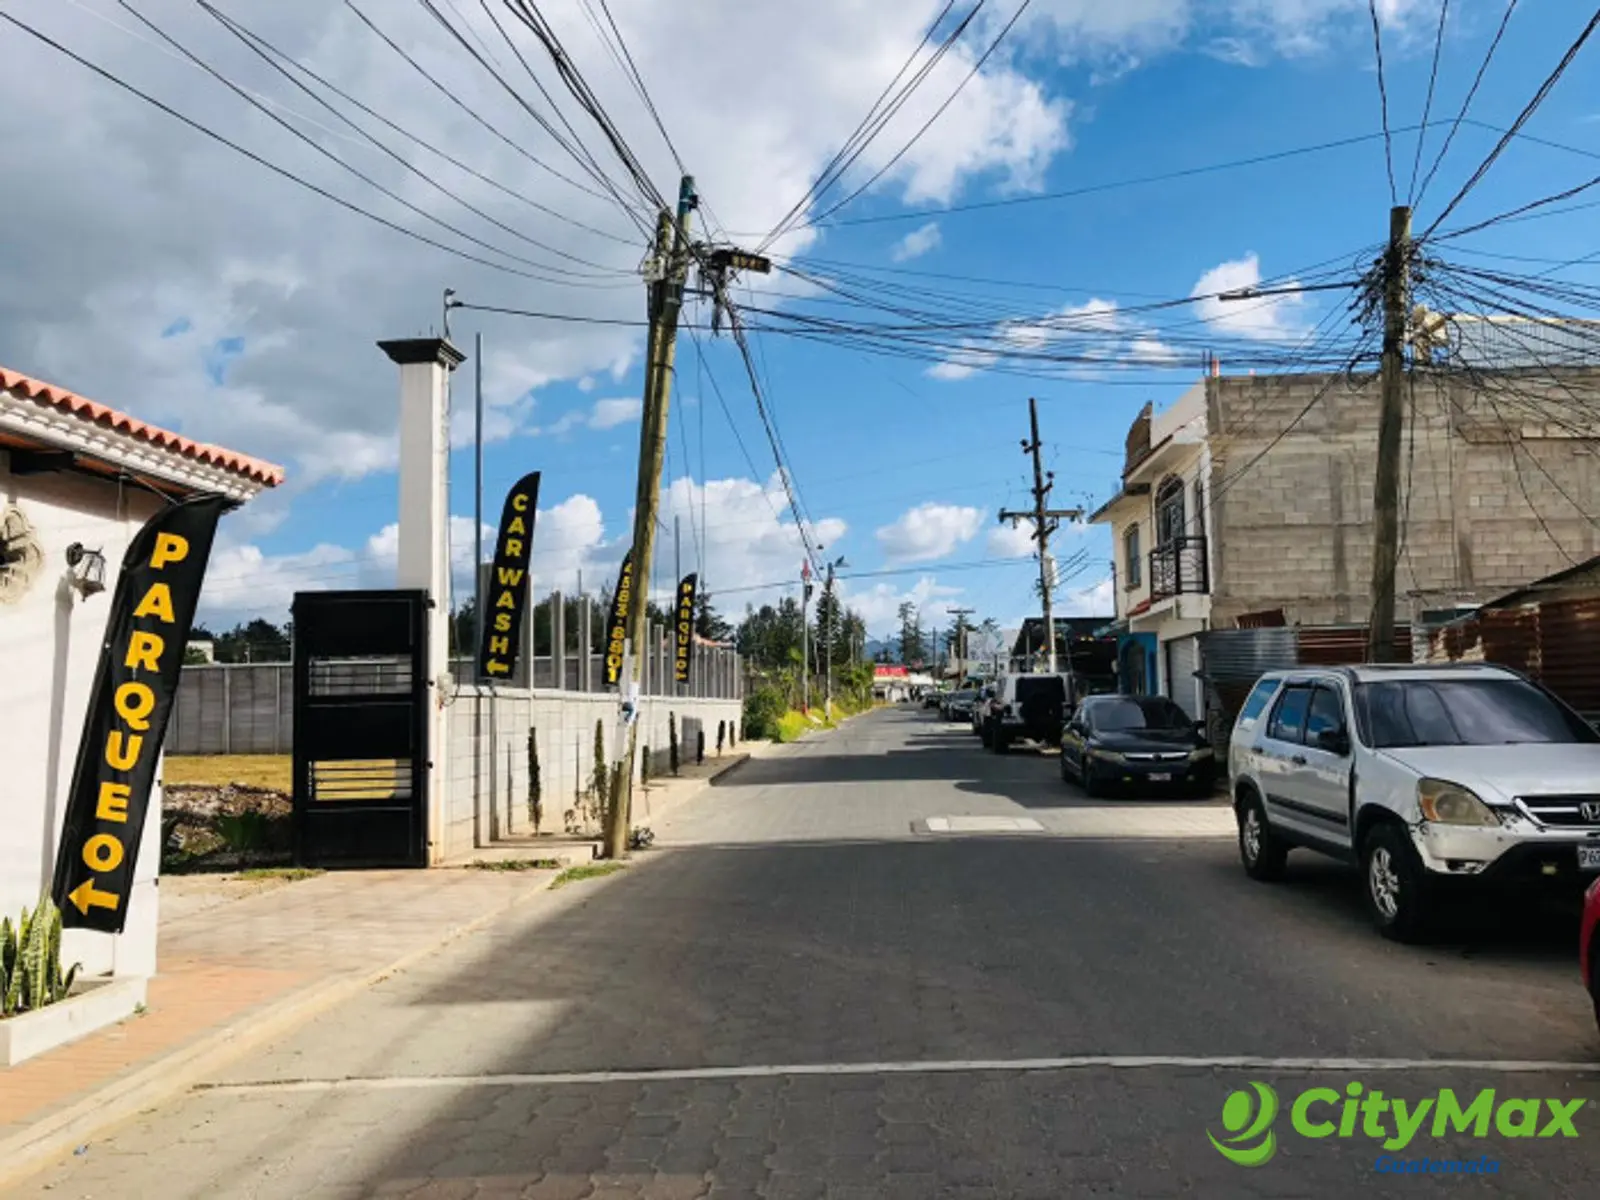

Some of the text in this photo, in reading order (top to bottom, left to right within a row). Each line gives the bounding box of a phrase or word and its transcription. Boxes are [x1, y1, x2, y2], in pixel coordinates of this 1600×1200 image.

[490, 493, 528, 654] CAR WASH
[675, 583, 692, 669] PARQUEO
[82, 532, 189, 872] PARQUEO
